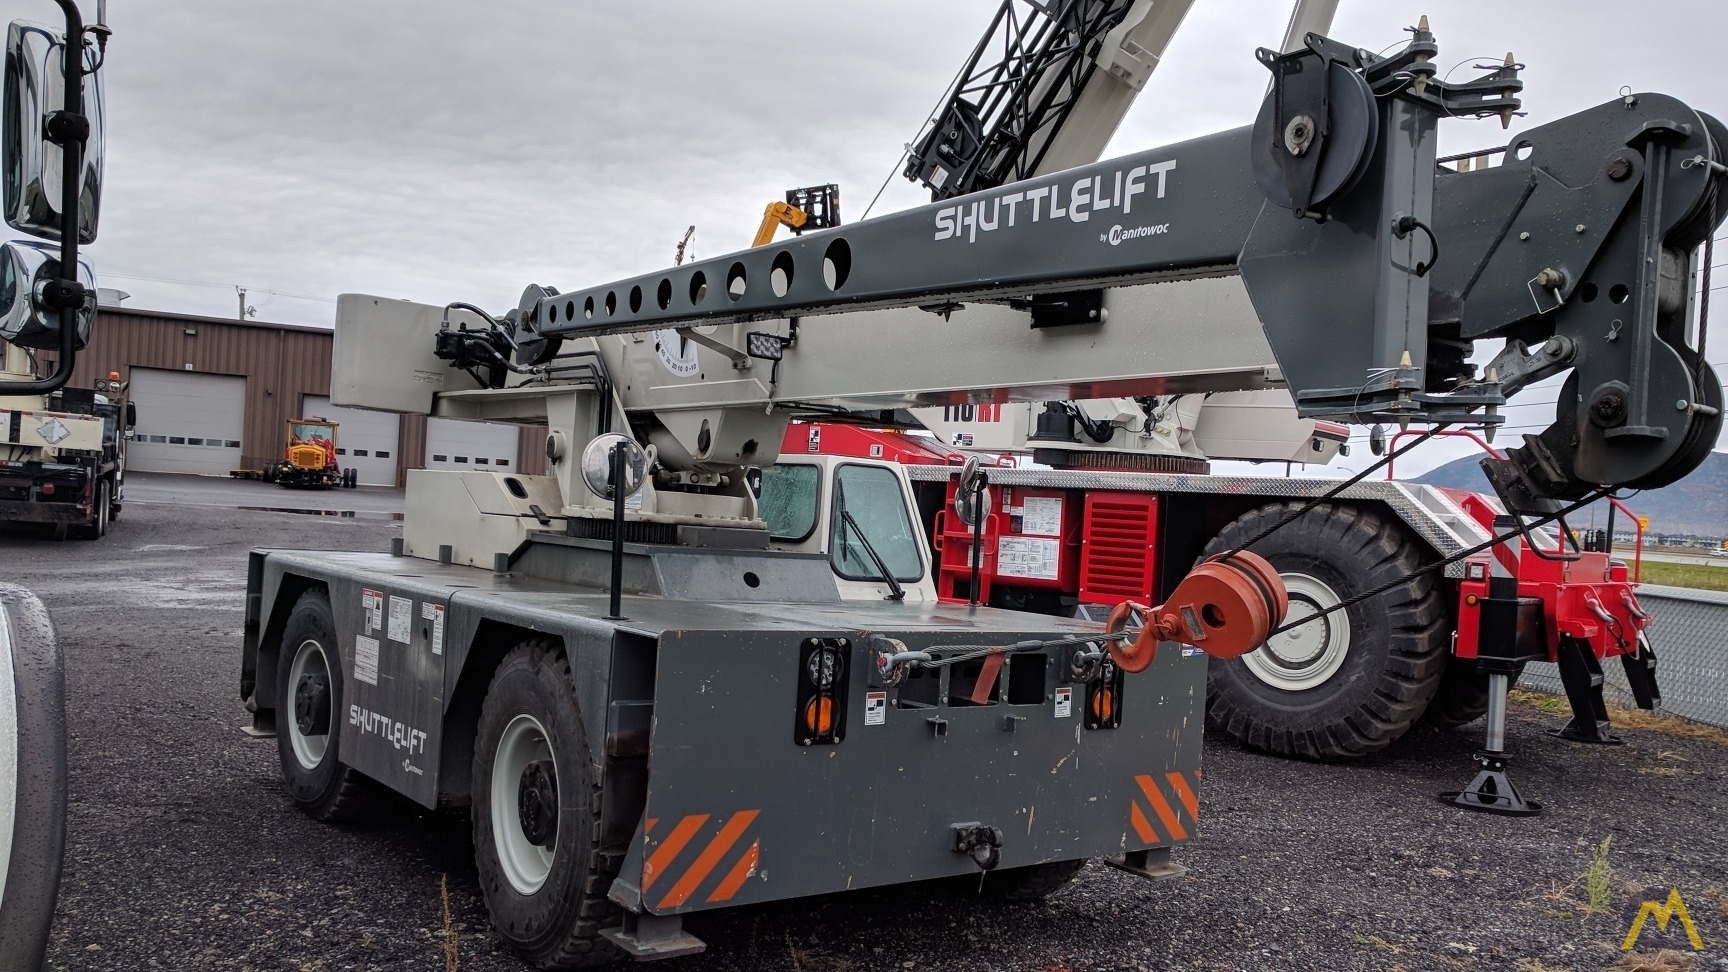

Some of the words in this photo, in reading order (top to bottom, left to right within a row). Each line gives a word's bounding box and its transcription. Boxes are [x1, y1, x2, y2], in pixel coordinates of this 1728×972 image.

[934, 159, 1177, 244] SHUTTLELIFT
[1109, 223, 1170, 246] Manitowoc
[349, 704, 427, 755] SHUTTLELIFT
